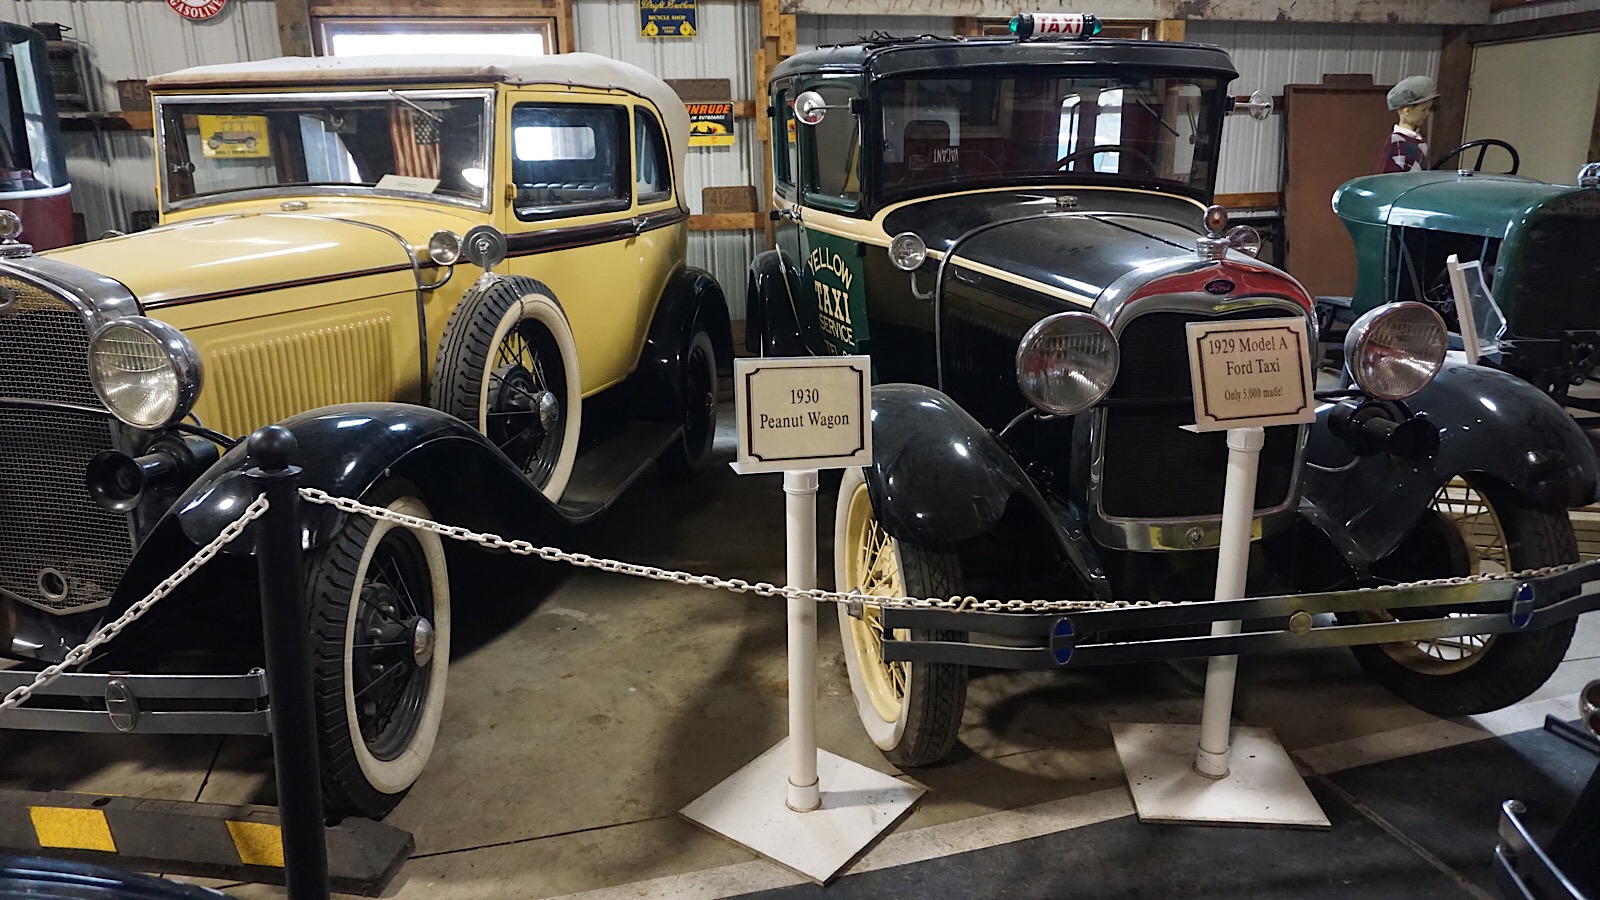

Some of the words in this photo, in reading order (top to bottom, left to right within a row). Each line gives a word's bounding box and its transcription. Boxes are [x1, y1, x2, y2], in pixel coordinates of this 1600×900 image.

[169, 0, 223, 18] GASOLINE
[1039, 17, 1081, 34] TAXI
[933, 148, 959, 163] VACANT
[807, 246, 853, 291] YELLOW
[814, 280, 852, 325] TAXI
[819, 313, 856, 347] SERVICE
[1208, 339, 1235, 355] 1929
[1238, 336, 1276, 352] Model
[1278, 336, 1288, 350] A
[1225, 360, 1253, 376] Ford
[1255, 358, 1280, 374] Taxi
[790, 388, 820, 405] 1930
[1224, 389, 1241, 402] Only
[1243, 388, 1262, 400] 5,000
[1263, 386, 1283, 399] made!
[759, 413, 804, 429] Peanut
[807, 411, 850, 429] Wagon
